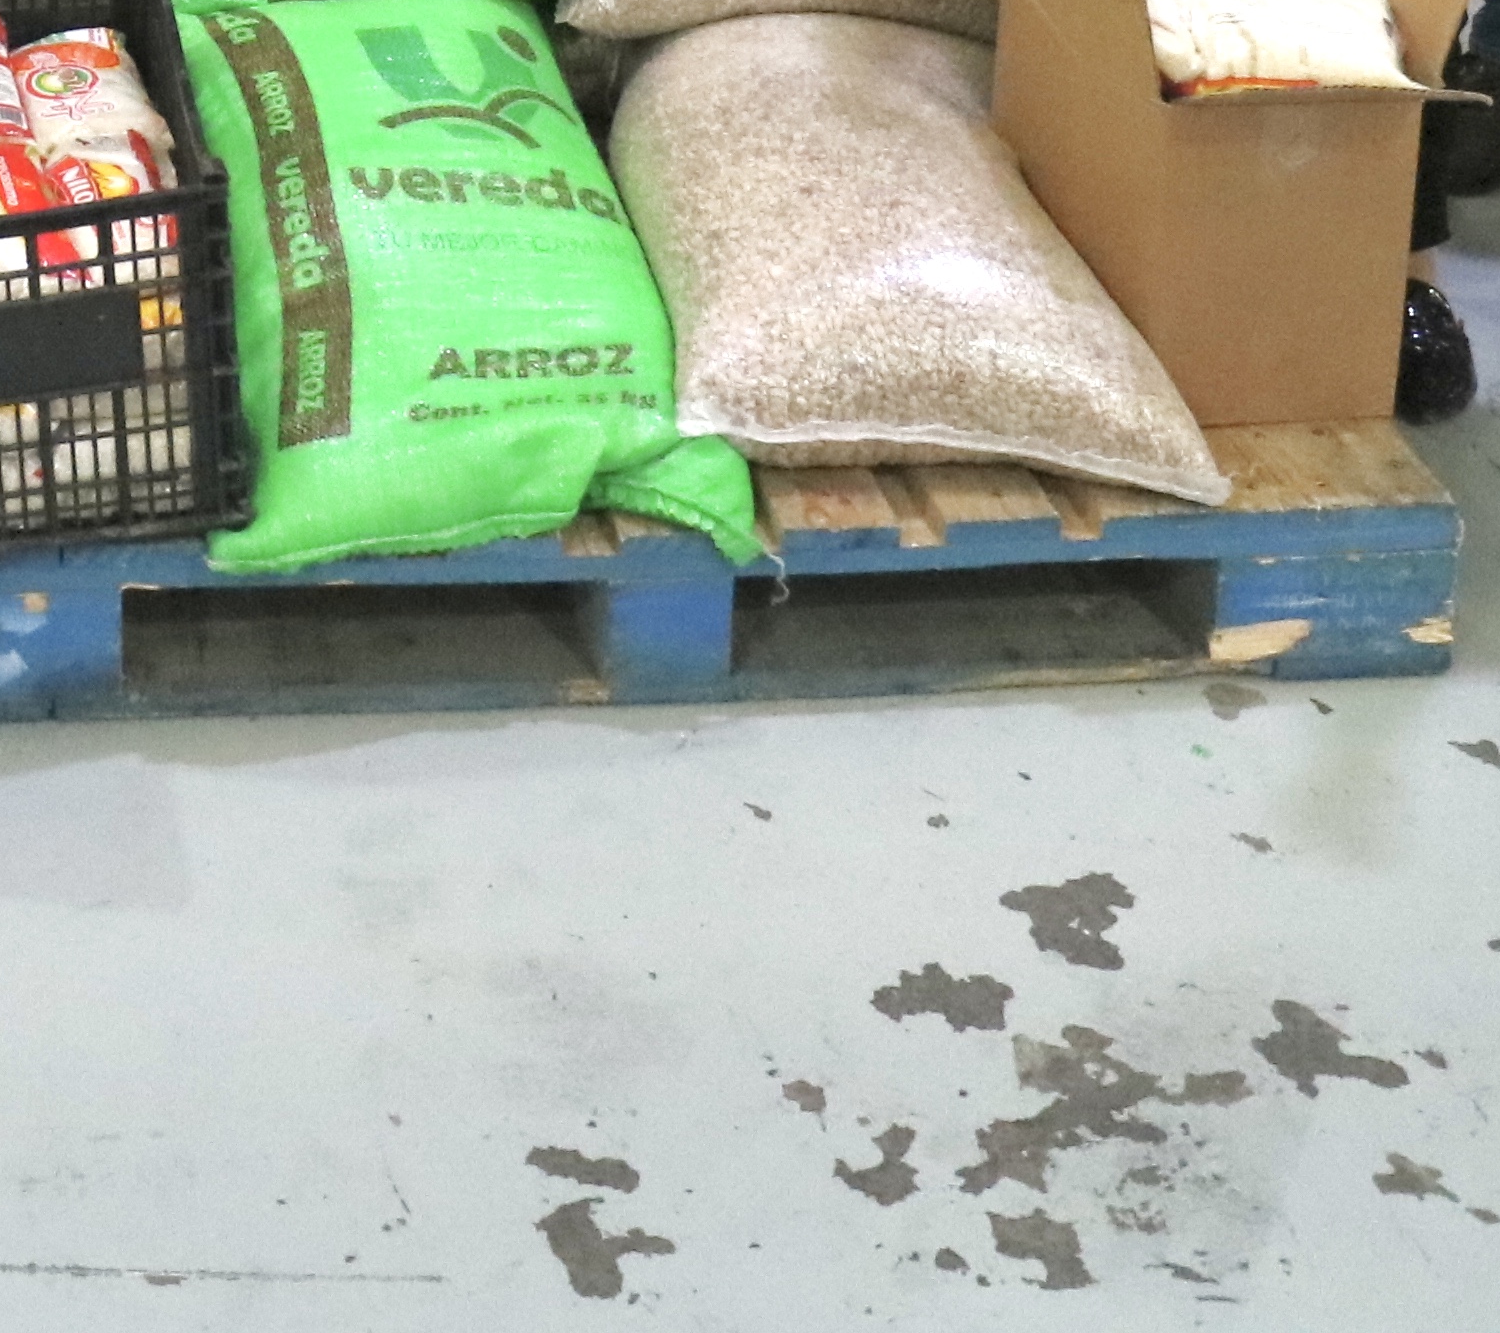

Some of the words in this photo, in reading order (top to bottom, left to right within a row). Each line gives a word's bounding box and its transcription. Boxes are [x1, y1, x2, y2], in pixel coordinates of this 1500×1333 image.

[253, 70, 295, 136] ARROZ
[275, 156, 330, 290] vereda
[296, 329, 327, 415] ARROZ
[428, 343, 635, 381] ARROZ
